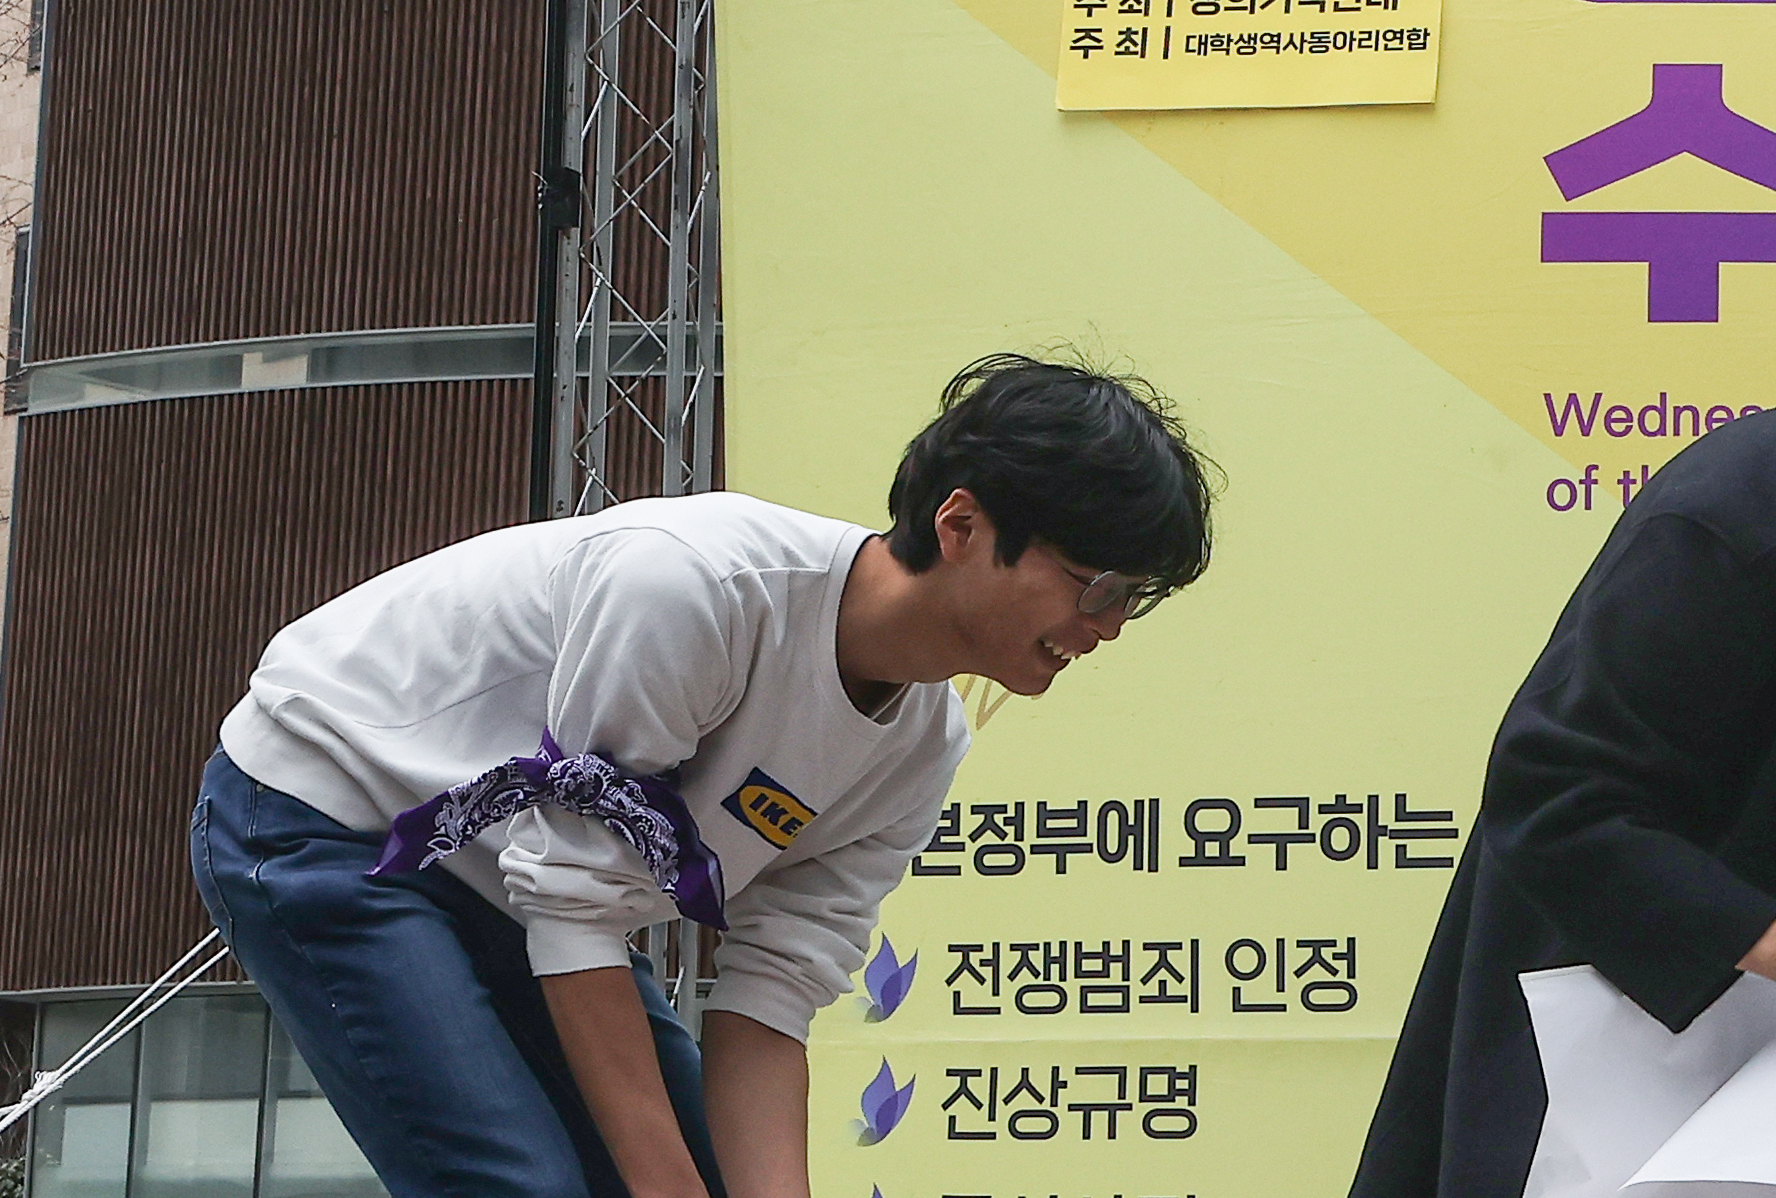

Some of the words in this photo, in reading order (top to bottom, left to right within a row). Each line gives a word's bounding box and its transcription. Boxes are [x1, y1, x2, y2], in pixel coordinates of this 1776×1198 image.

[1184, 28, 1431, 57] 대학생역사동아리연합
[1546, 464, 1599, 512] of
[1178, 792, 1459, 872] 요구하는
[944, 938, 1200, 1017] 전쟁범죄
[1224, 936, 1359, 1014] 인정
[940, 1063, 1199, 1142] 진상규명
